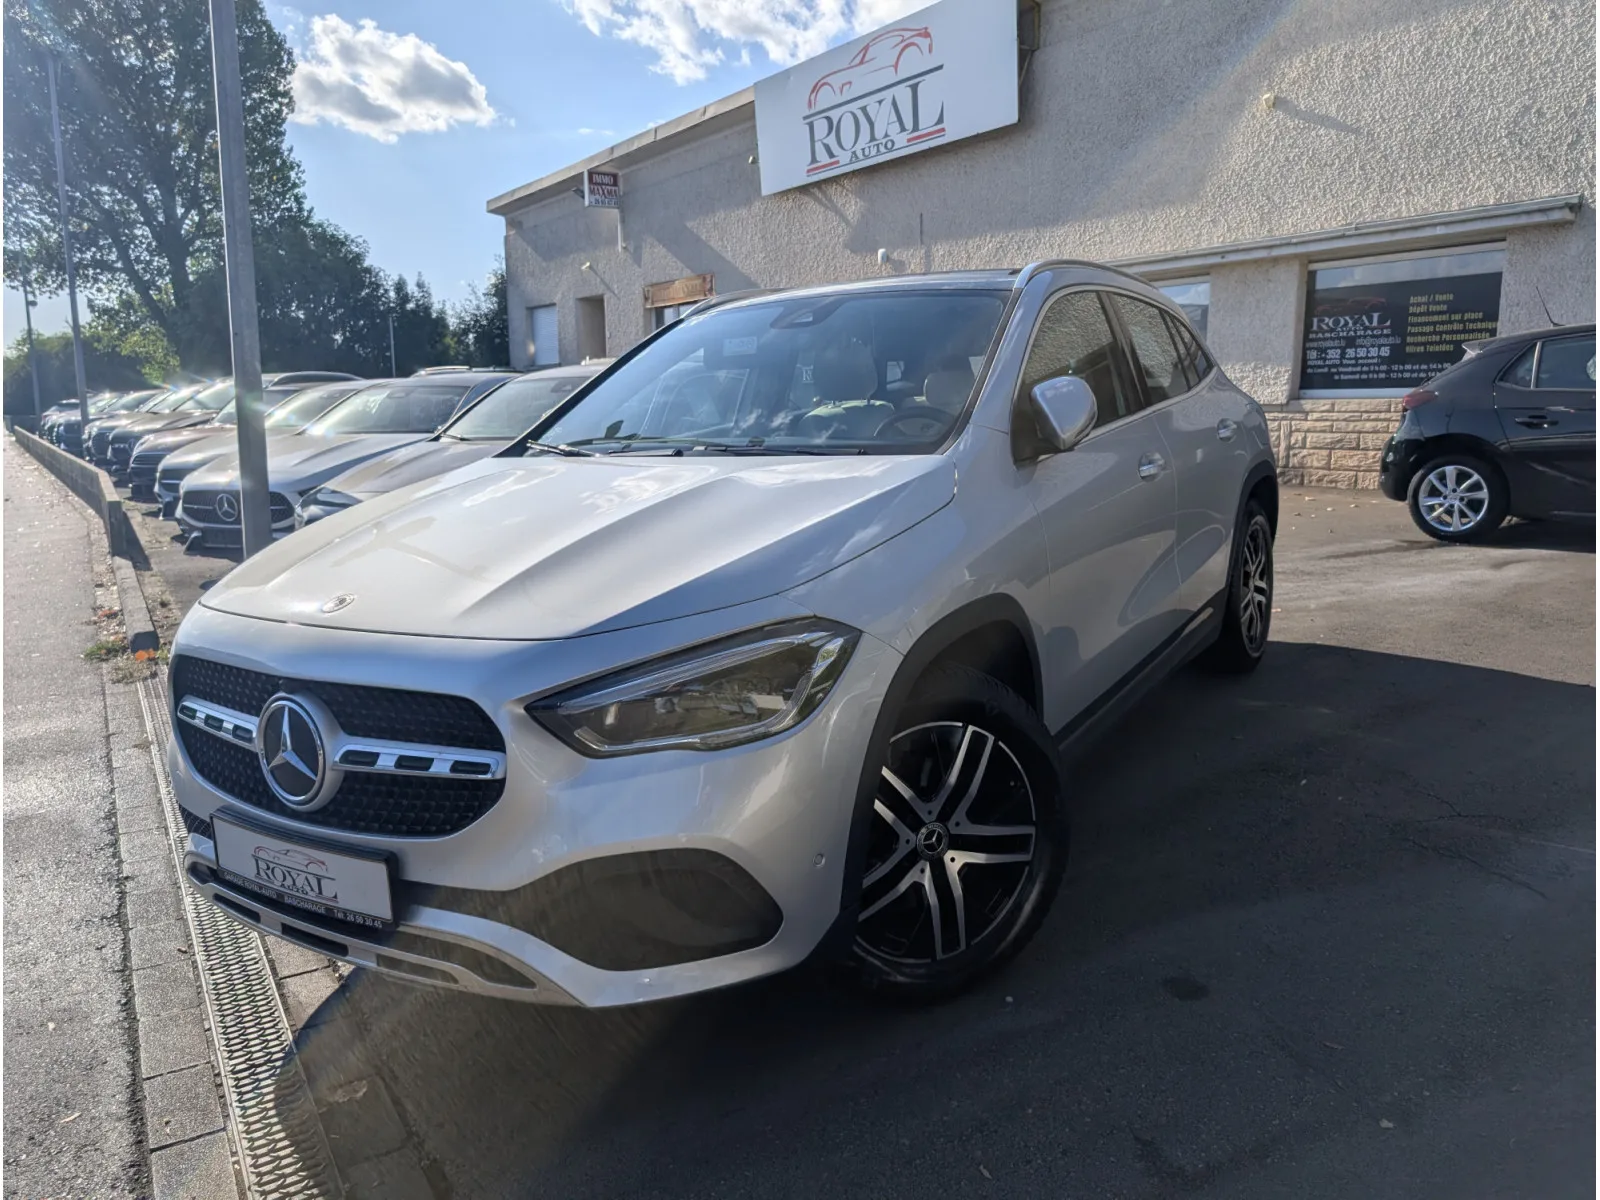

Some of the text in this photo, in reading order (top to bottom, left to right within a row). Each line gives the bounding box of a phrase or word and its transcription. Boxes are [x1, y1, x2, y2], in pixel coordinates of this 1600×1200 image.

[804, 79, 945, 166] ROYAL
[849, 138, 896, 162] AUTO
[592, 173, 614, 185] IMMO
[1410, 295, 1428, 304] Achat
[1435, 293, 1454, 301] Vente
[1429, 304, 1448, 312] Vente
[1310, 312, 1391, 331] ROYAL
[1464, 312, 1483, 320] place
[1407, 325, 1434, 333] Passage
[1465, 321, 1497, 330] Techniqu
[1308, 329, 1392, 339] BASCHARAGE
[1326, 349, 1341, 359] 352
[1345, 348, 1356, 358] 26
[1356, 347, 1367, 357] 50
[1368, 346, 1379, 357] 30
[1379, 346, 1390, 356] 45
[253, 858, 338, 900] ROYAL
[280, 883, 308, 896] AUTO
[284, 893, 326, 914] BASCHARAGE
[346, 913, 355, 921] 26
[355, 915, 364, 924] 50
[364, 917, 373, 926] 30
[373, 919, 383, 929] 45
